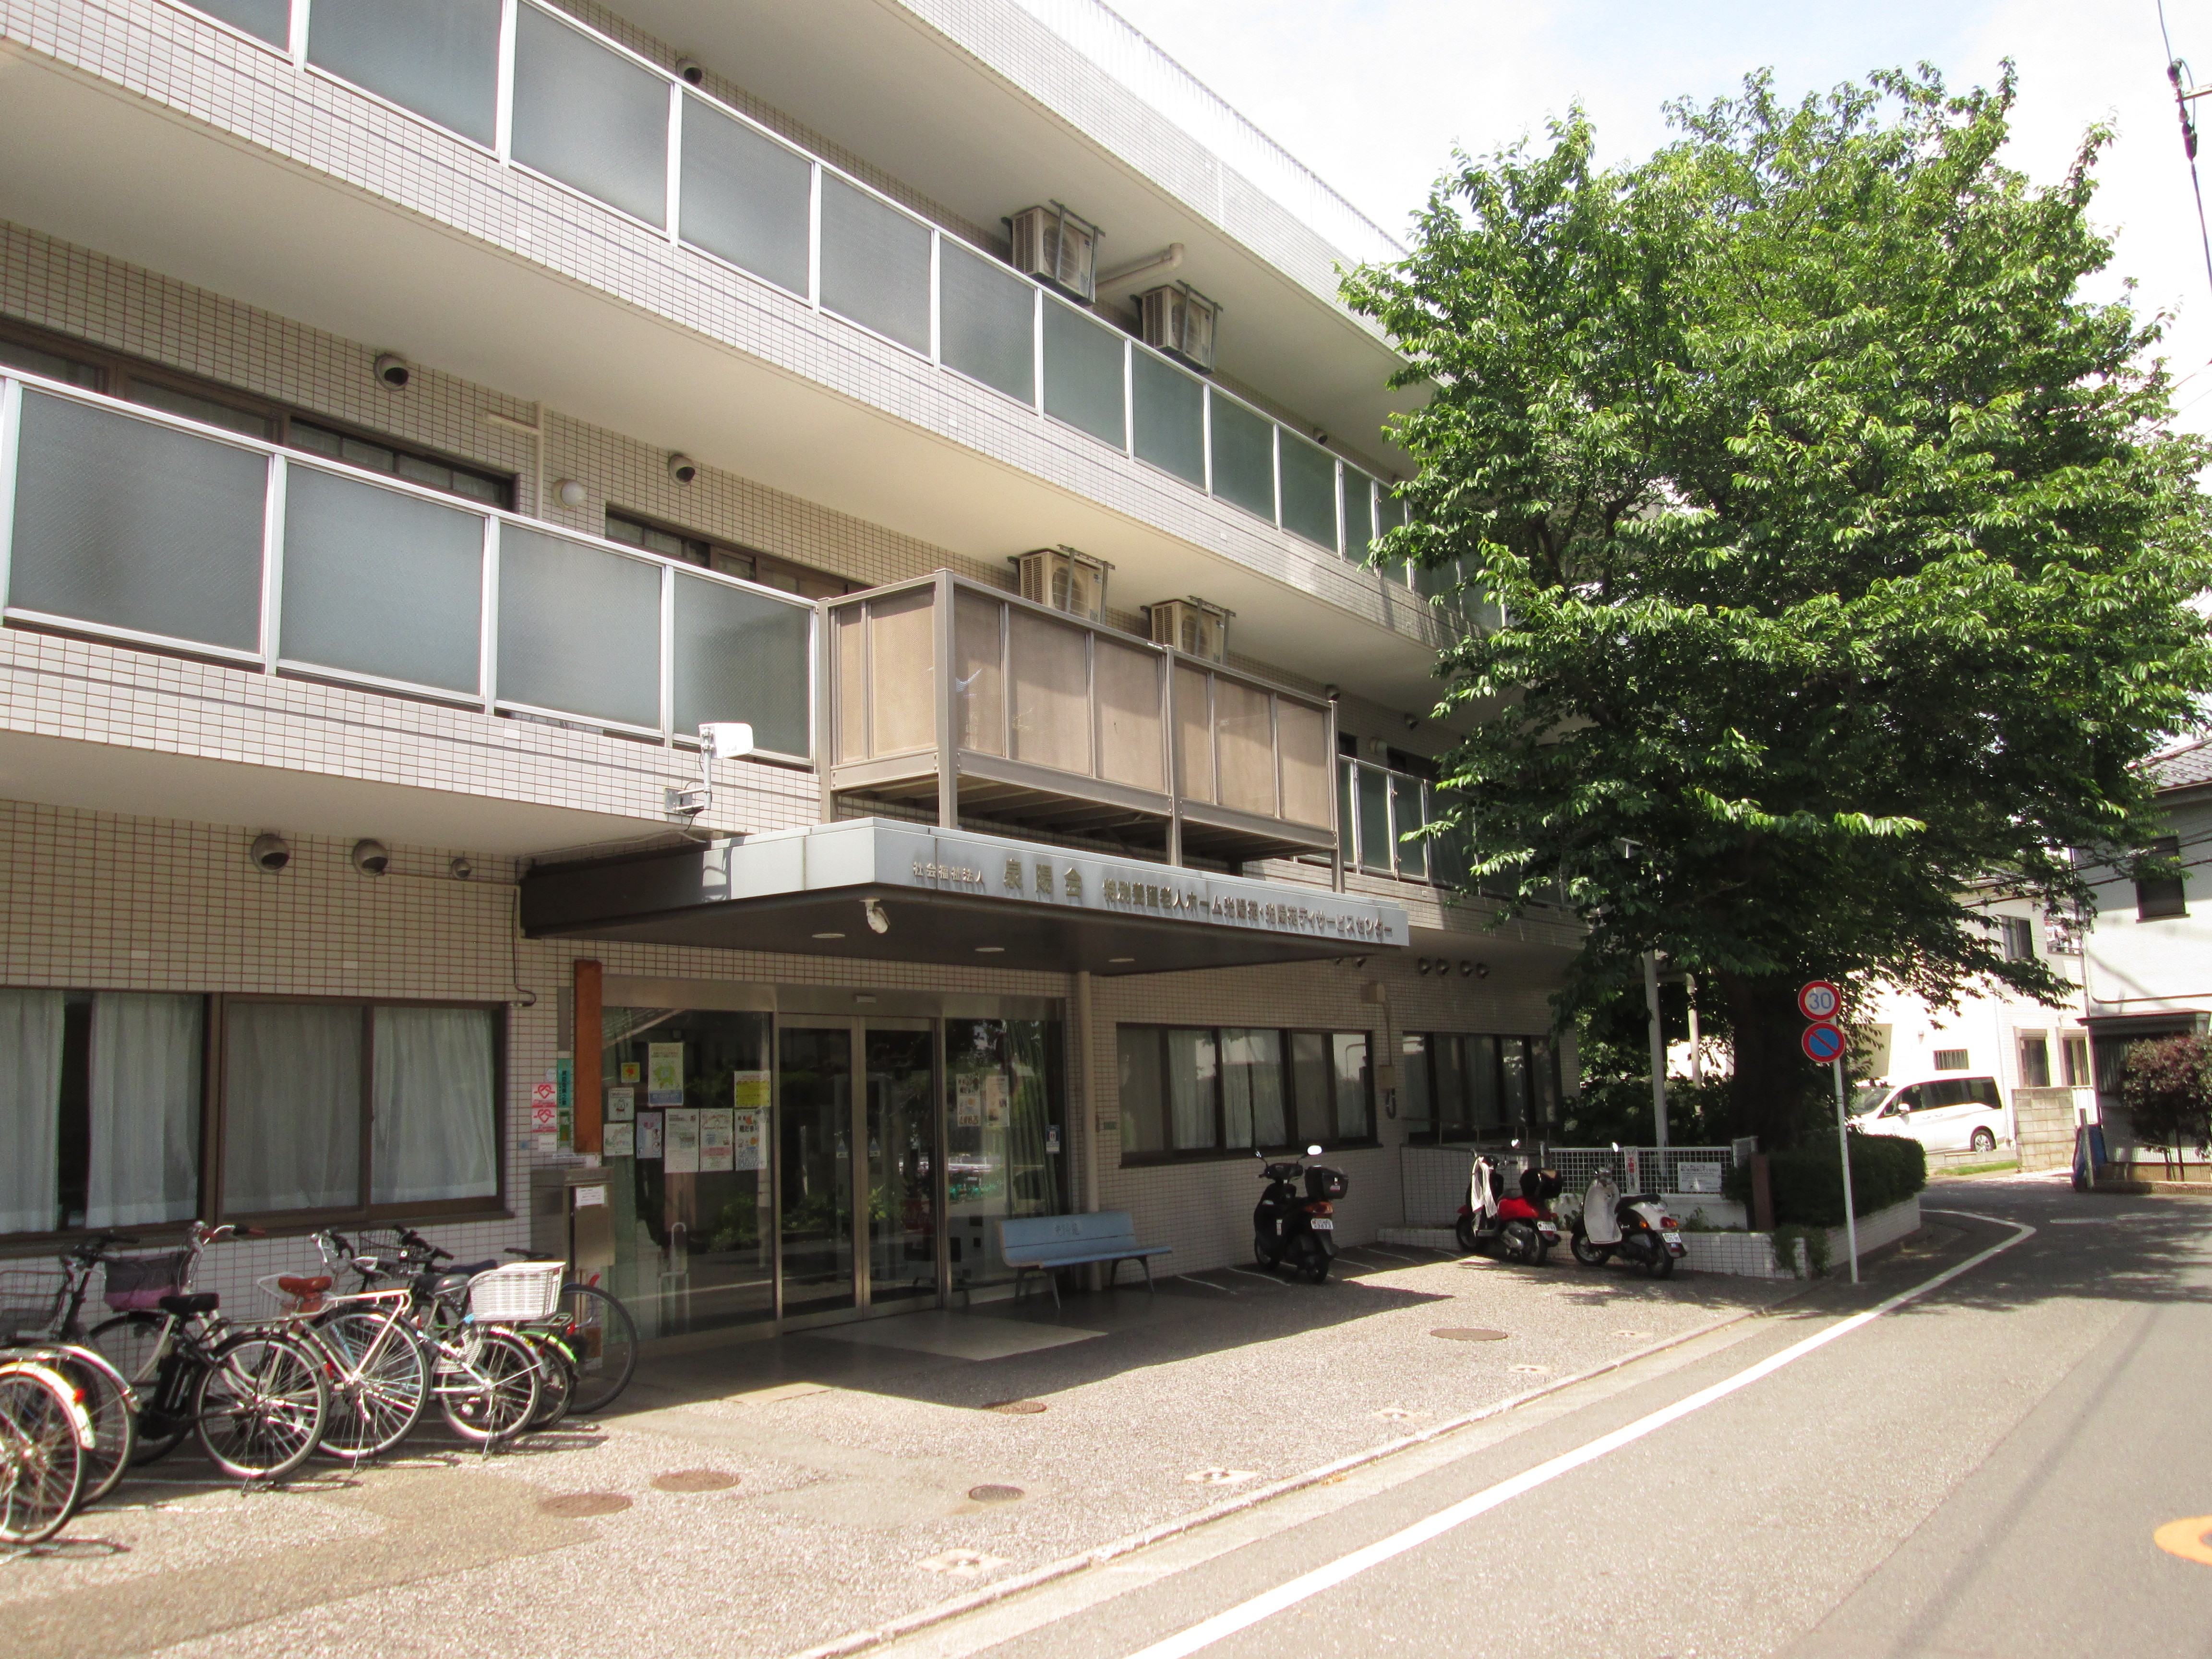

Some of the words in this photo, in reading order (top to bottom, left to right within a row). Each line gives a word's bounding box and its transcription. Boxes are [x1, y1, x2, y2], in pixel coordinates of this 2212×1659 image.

[913, 862, 985, 884] 社会福祉法人
[1003, 858, 1082, 897] 泉陽会
[1809, 992, 1832, 1010] 30
